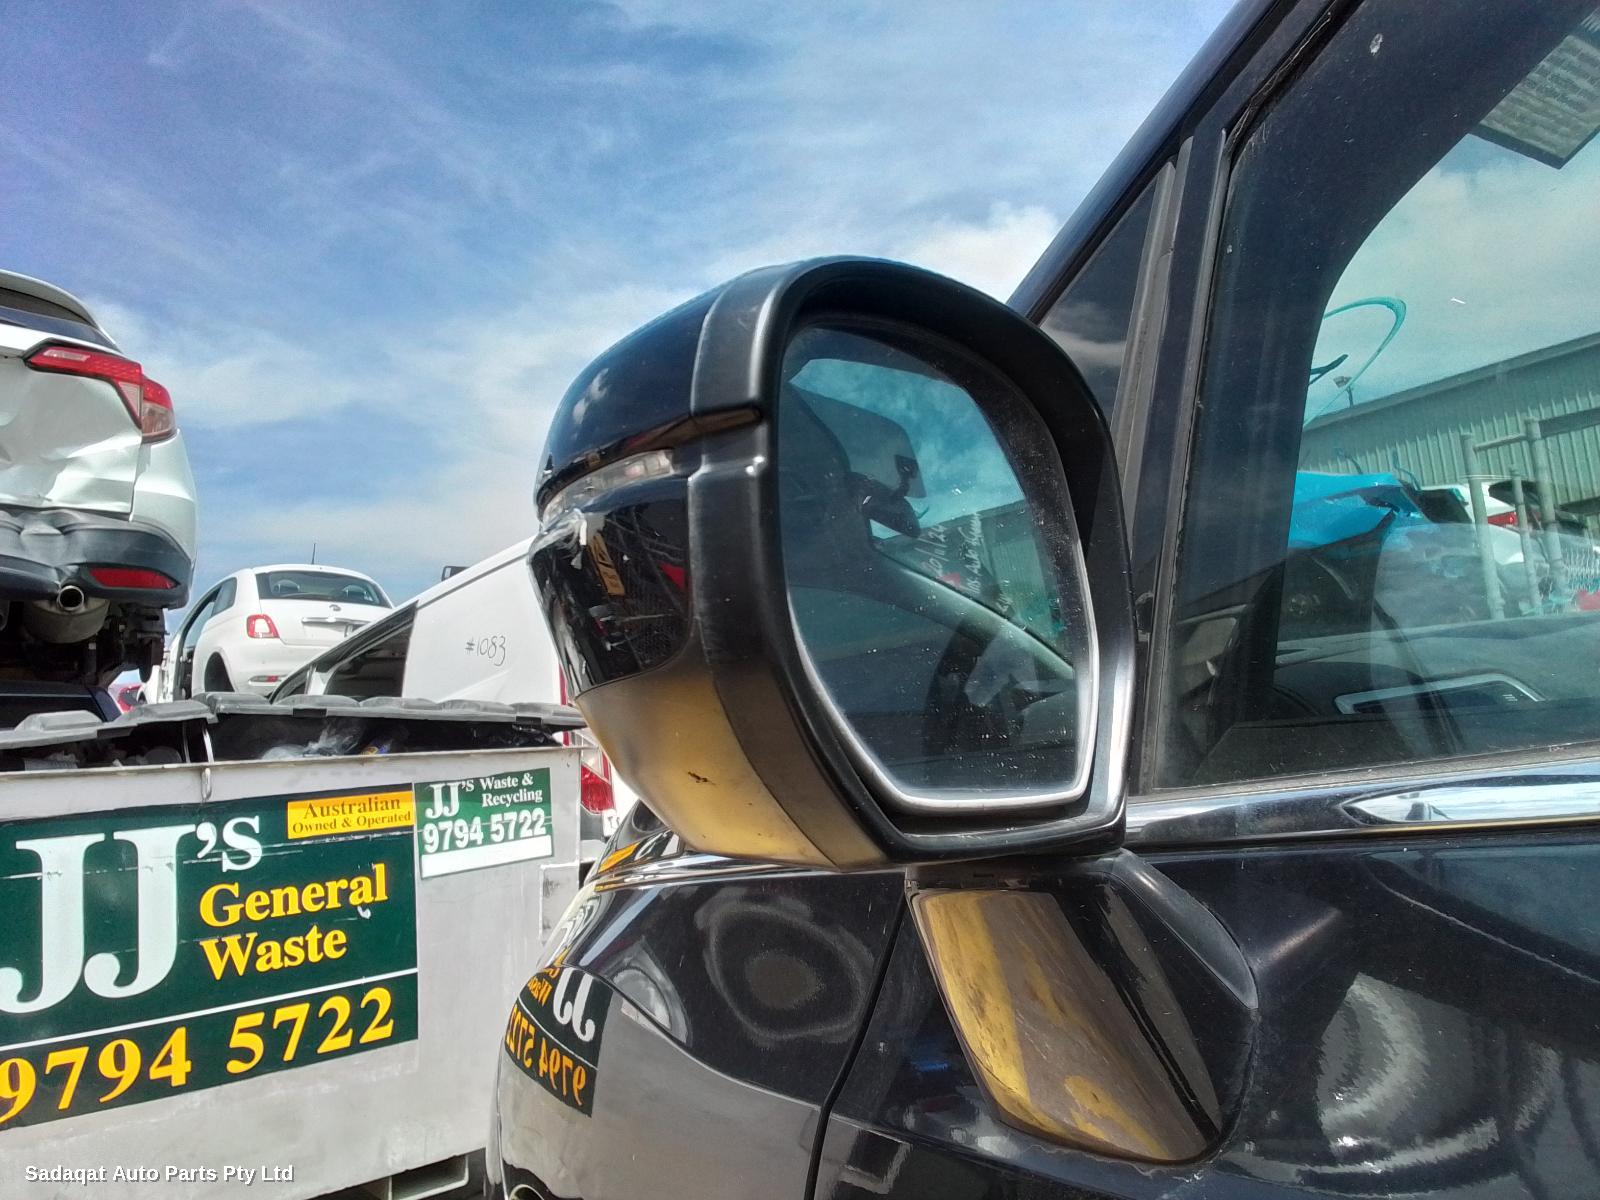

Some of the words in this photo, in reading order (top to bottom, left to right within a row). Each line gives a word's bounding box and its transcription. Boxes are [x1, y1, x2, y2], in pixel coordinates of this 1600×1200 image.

[464, 635, 506, 667] #1083
[480, 775, 519, 792] Waste
[522, 773, 534, 786] &
[481, 789, 543, 808] Recycling
[292, 819, 337, 834] Owned
[341, 817, 352, 829] &
[356, 811, 411, 828] Operated
[303, 796, 401, 819] Australian
[423, 816, 484, 854] 9794
[490, 807, 547, 842] 5722
[200, 862, 389, 928] General
[199, 924, 348, 981] Waste
[0, 1026, 192, 1124] 9794
[226, 987, 395, 1075] 5722
